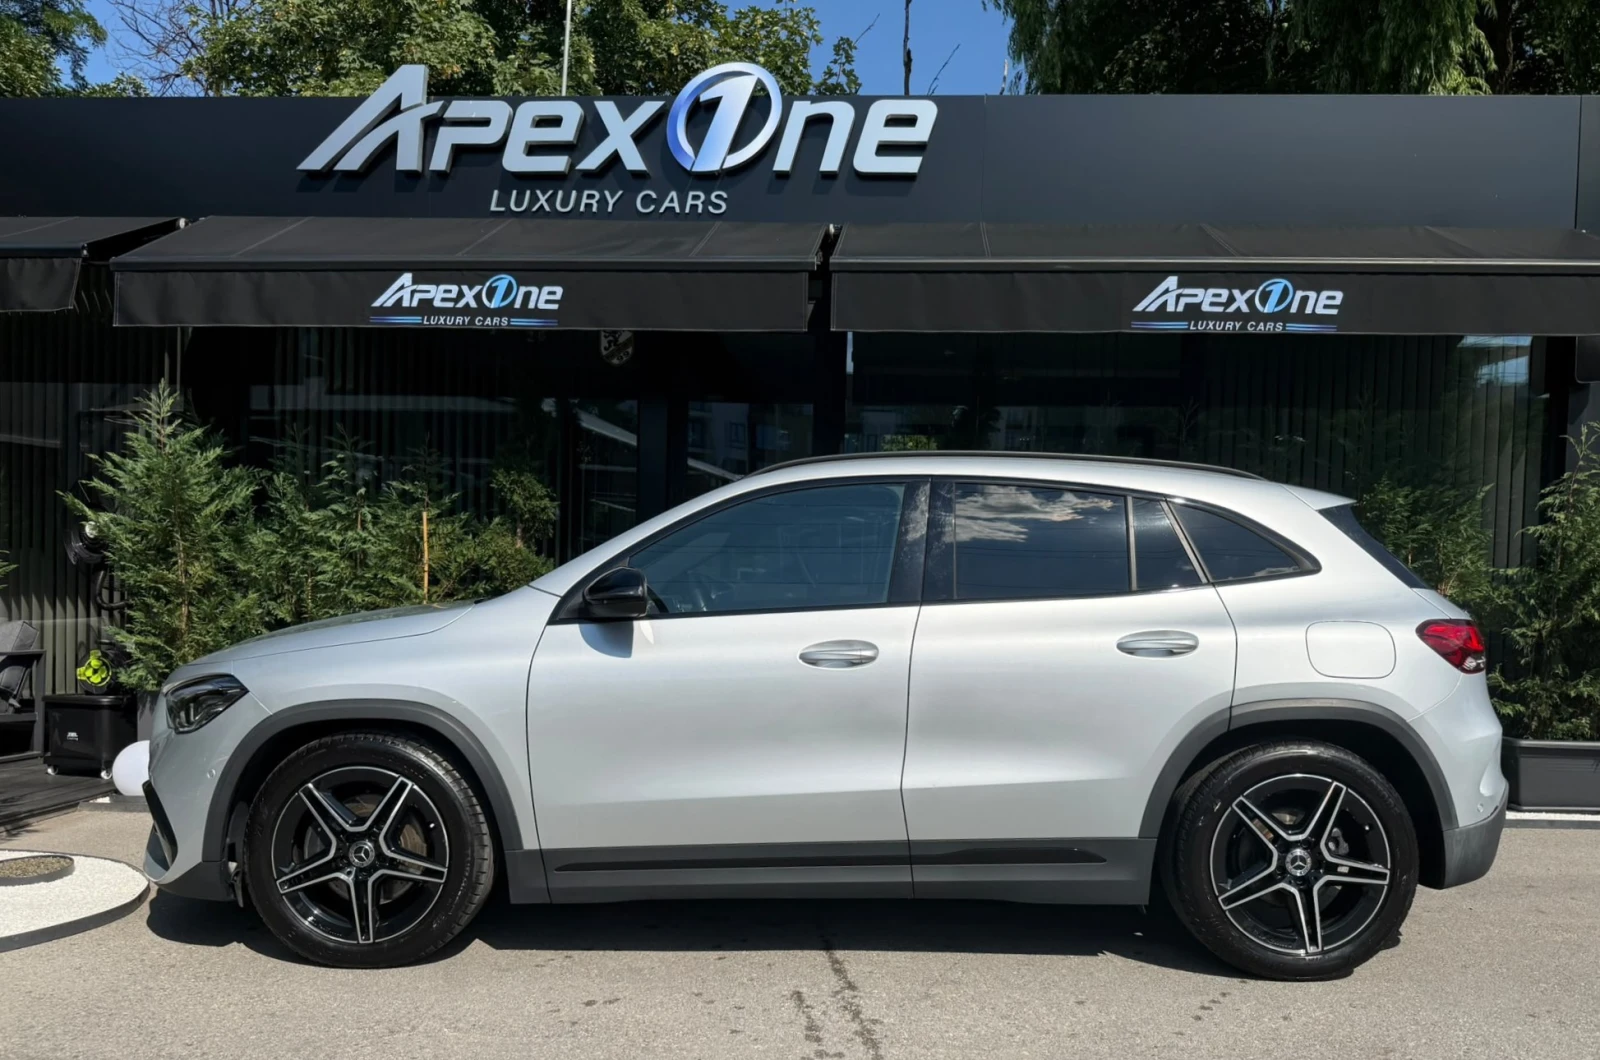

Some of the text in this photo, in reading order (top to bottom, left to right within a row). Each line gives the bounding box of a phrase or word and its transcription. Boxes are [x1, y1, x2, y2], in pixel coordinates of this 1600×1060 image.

[489, 189, 729, 215] LUXURY CARS
[422, 315, 509, 327] LUXURY CARS
[1189, 320, 1284, 332] LUXURY CARS
